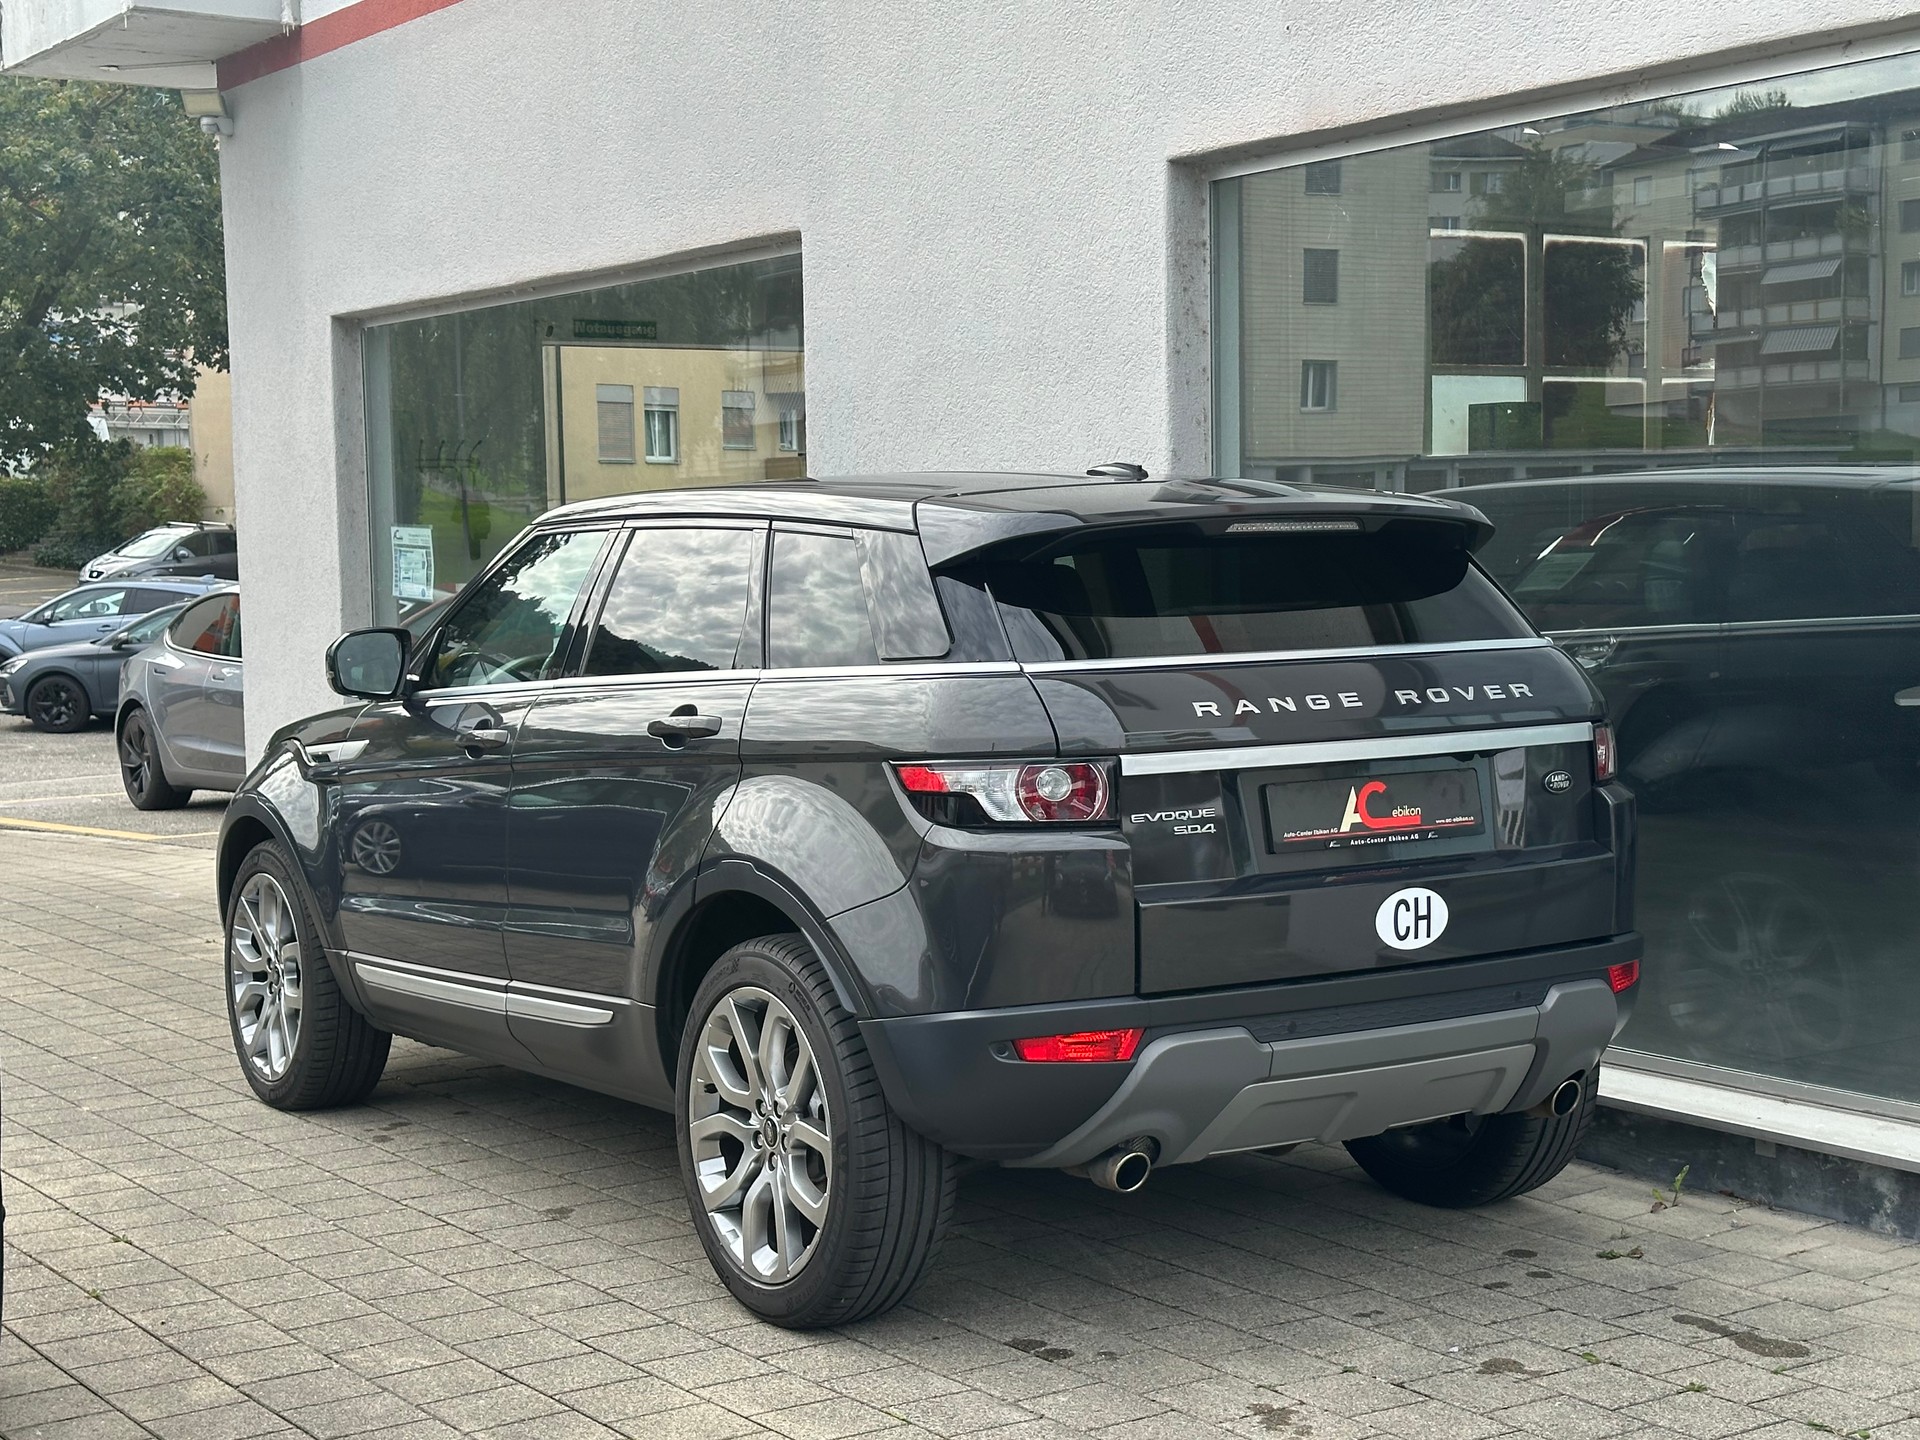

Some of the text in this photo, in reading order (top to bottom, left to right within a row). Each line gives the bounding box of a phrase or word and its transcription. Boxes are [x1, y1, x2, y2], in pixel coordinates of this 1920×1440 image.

[575, 321, 656, 337] Notausgang
[1192, 683, 1534, 717] RANGE ROVER
[1340, 781, 1421, 833] AC
[1392, 805, 1421, 817] ebikon
[1131, 808, 1216, 823] EVOQUE
[1173, 823, 1216, 835] SD4
[1284, 830, 1313, 838] Auto-Center
[1350, 837, 1386, 846] Auto-Center
[1393, 896, 1431, 941] CH
